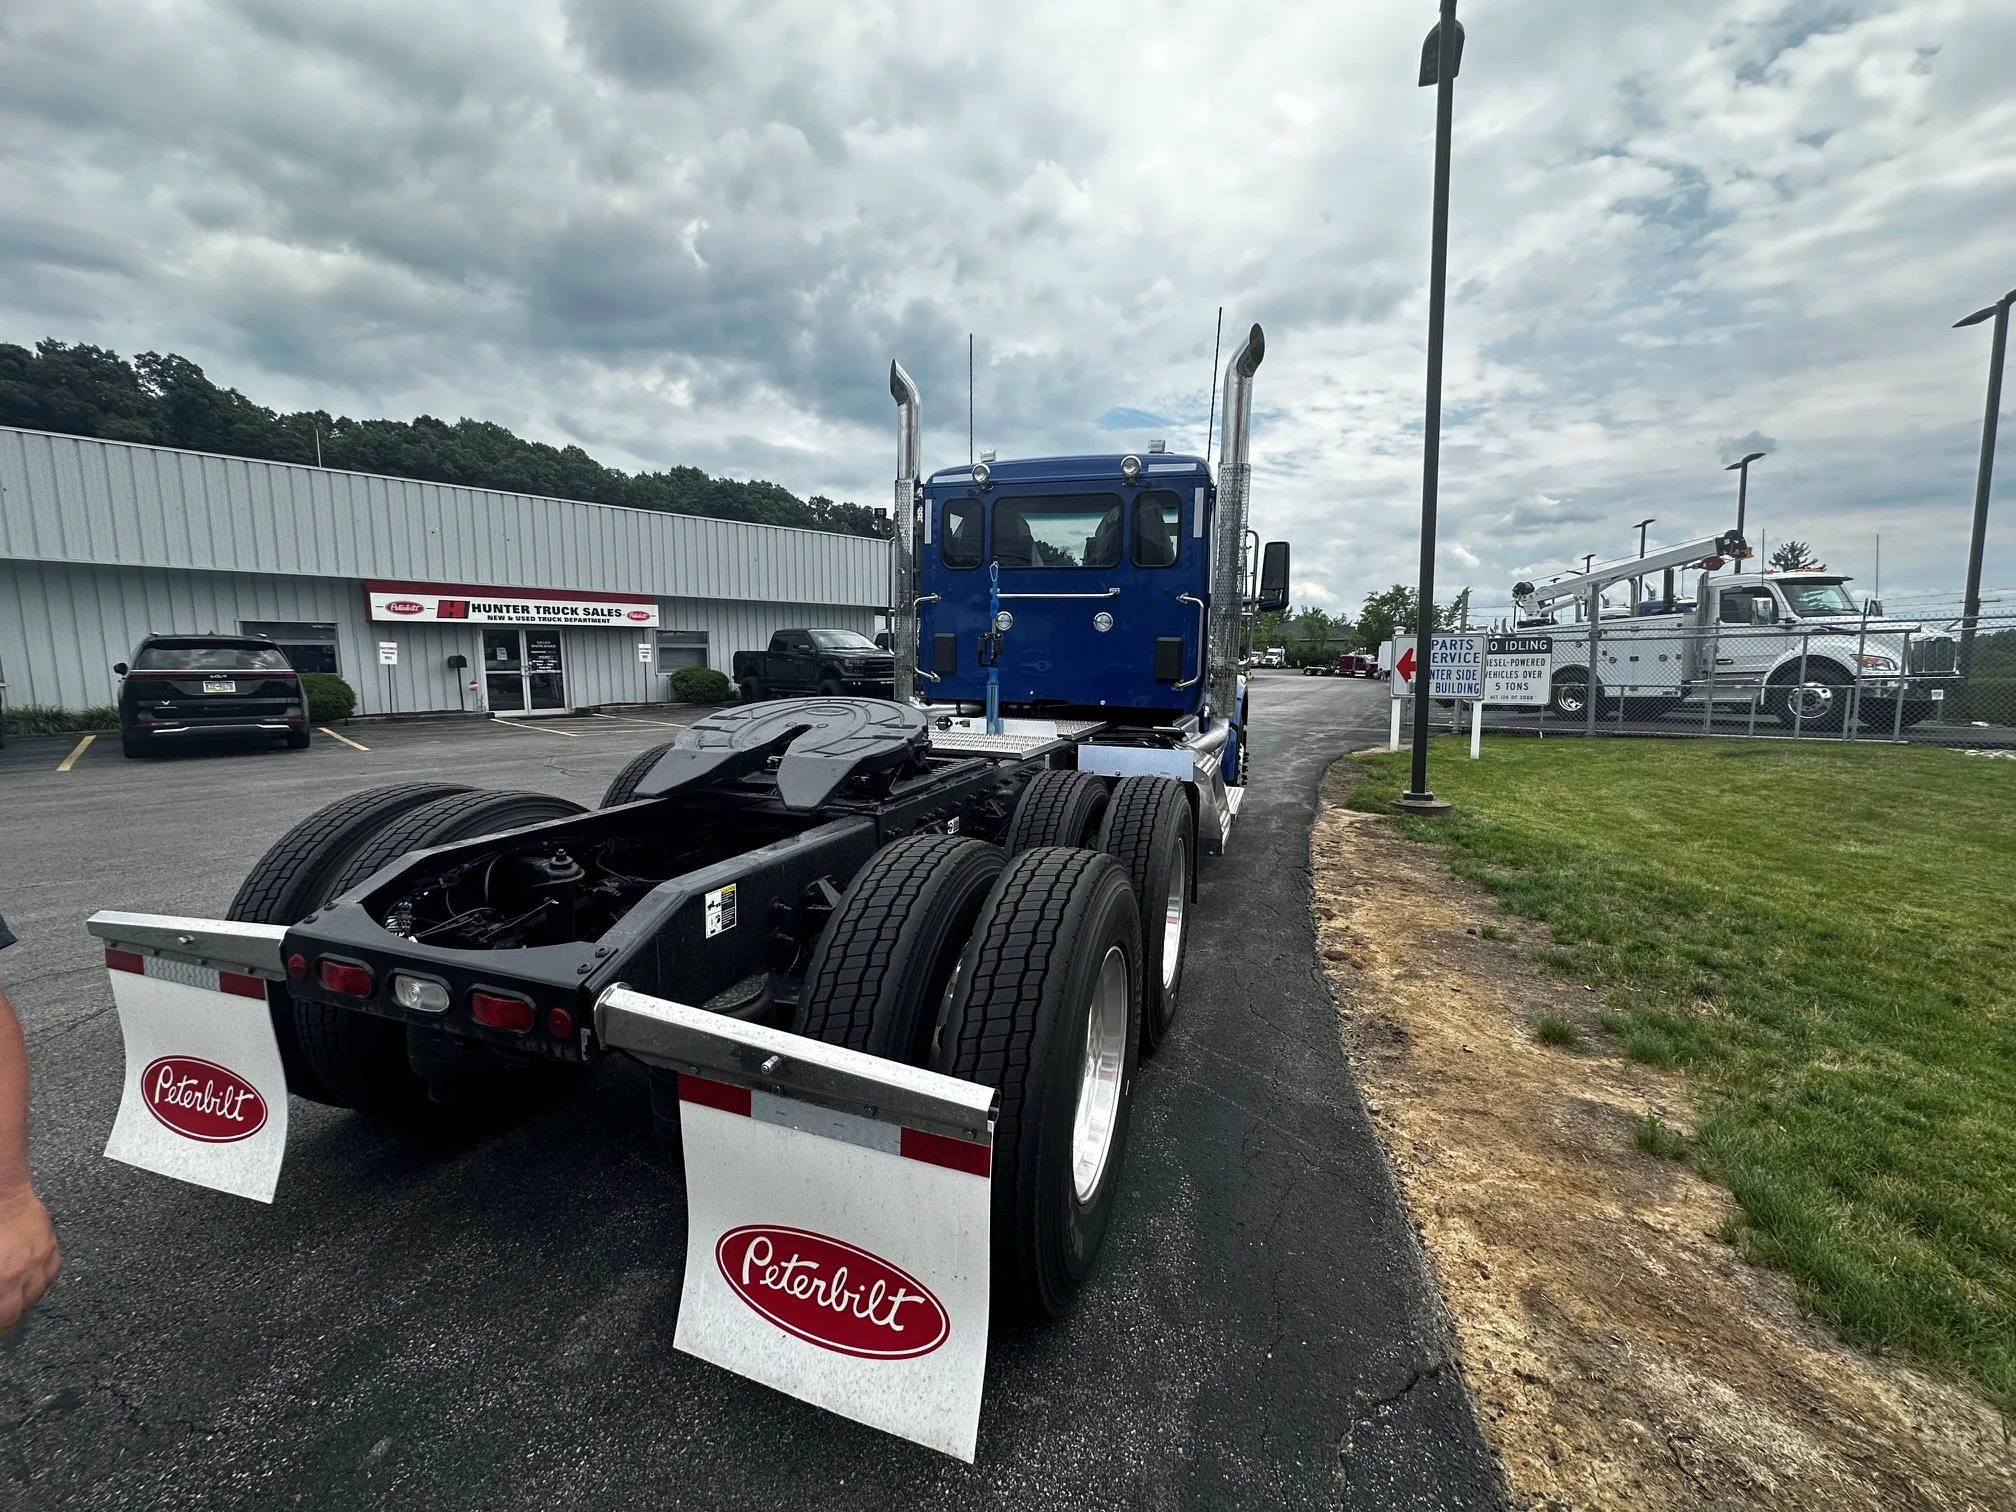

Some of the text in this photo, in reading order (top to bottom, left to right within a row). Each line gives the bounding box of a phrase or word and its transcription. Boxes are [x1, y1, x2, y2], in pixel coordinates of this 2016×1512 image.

[471, 603, 622, 618] HUNTER TRUCK SALES
[1431, 639, 1474, 651] PARTS
[1490, 640, 1547, 651] O IDLING
[1432, 652, 1481, 664] ERVICE
[1487, 658, 1546, 667] IESEL-POWERED
[1430, 669, 1478, 681] NTER SIDE
[1522, 670, 1543, 679] OVER
[1435, 682, 1480, 694] BUILDING
[1495, 682, 1529, 691] 5 TONS
[153, 1065, 255, 1122] Peterbilt
[741, 1236, 926, 1332] Peterbilt
